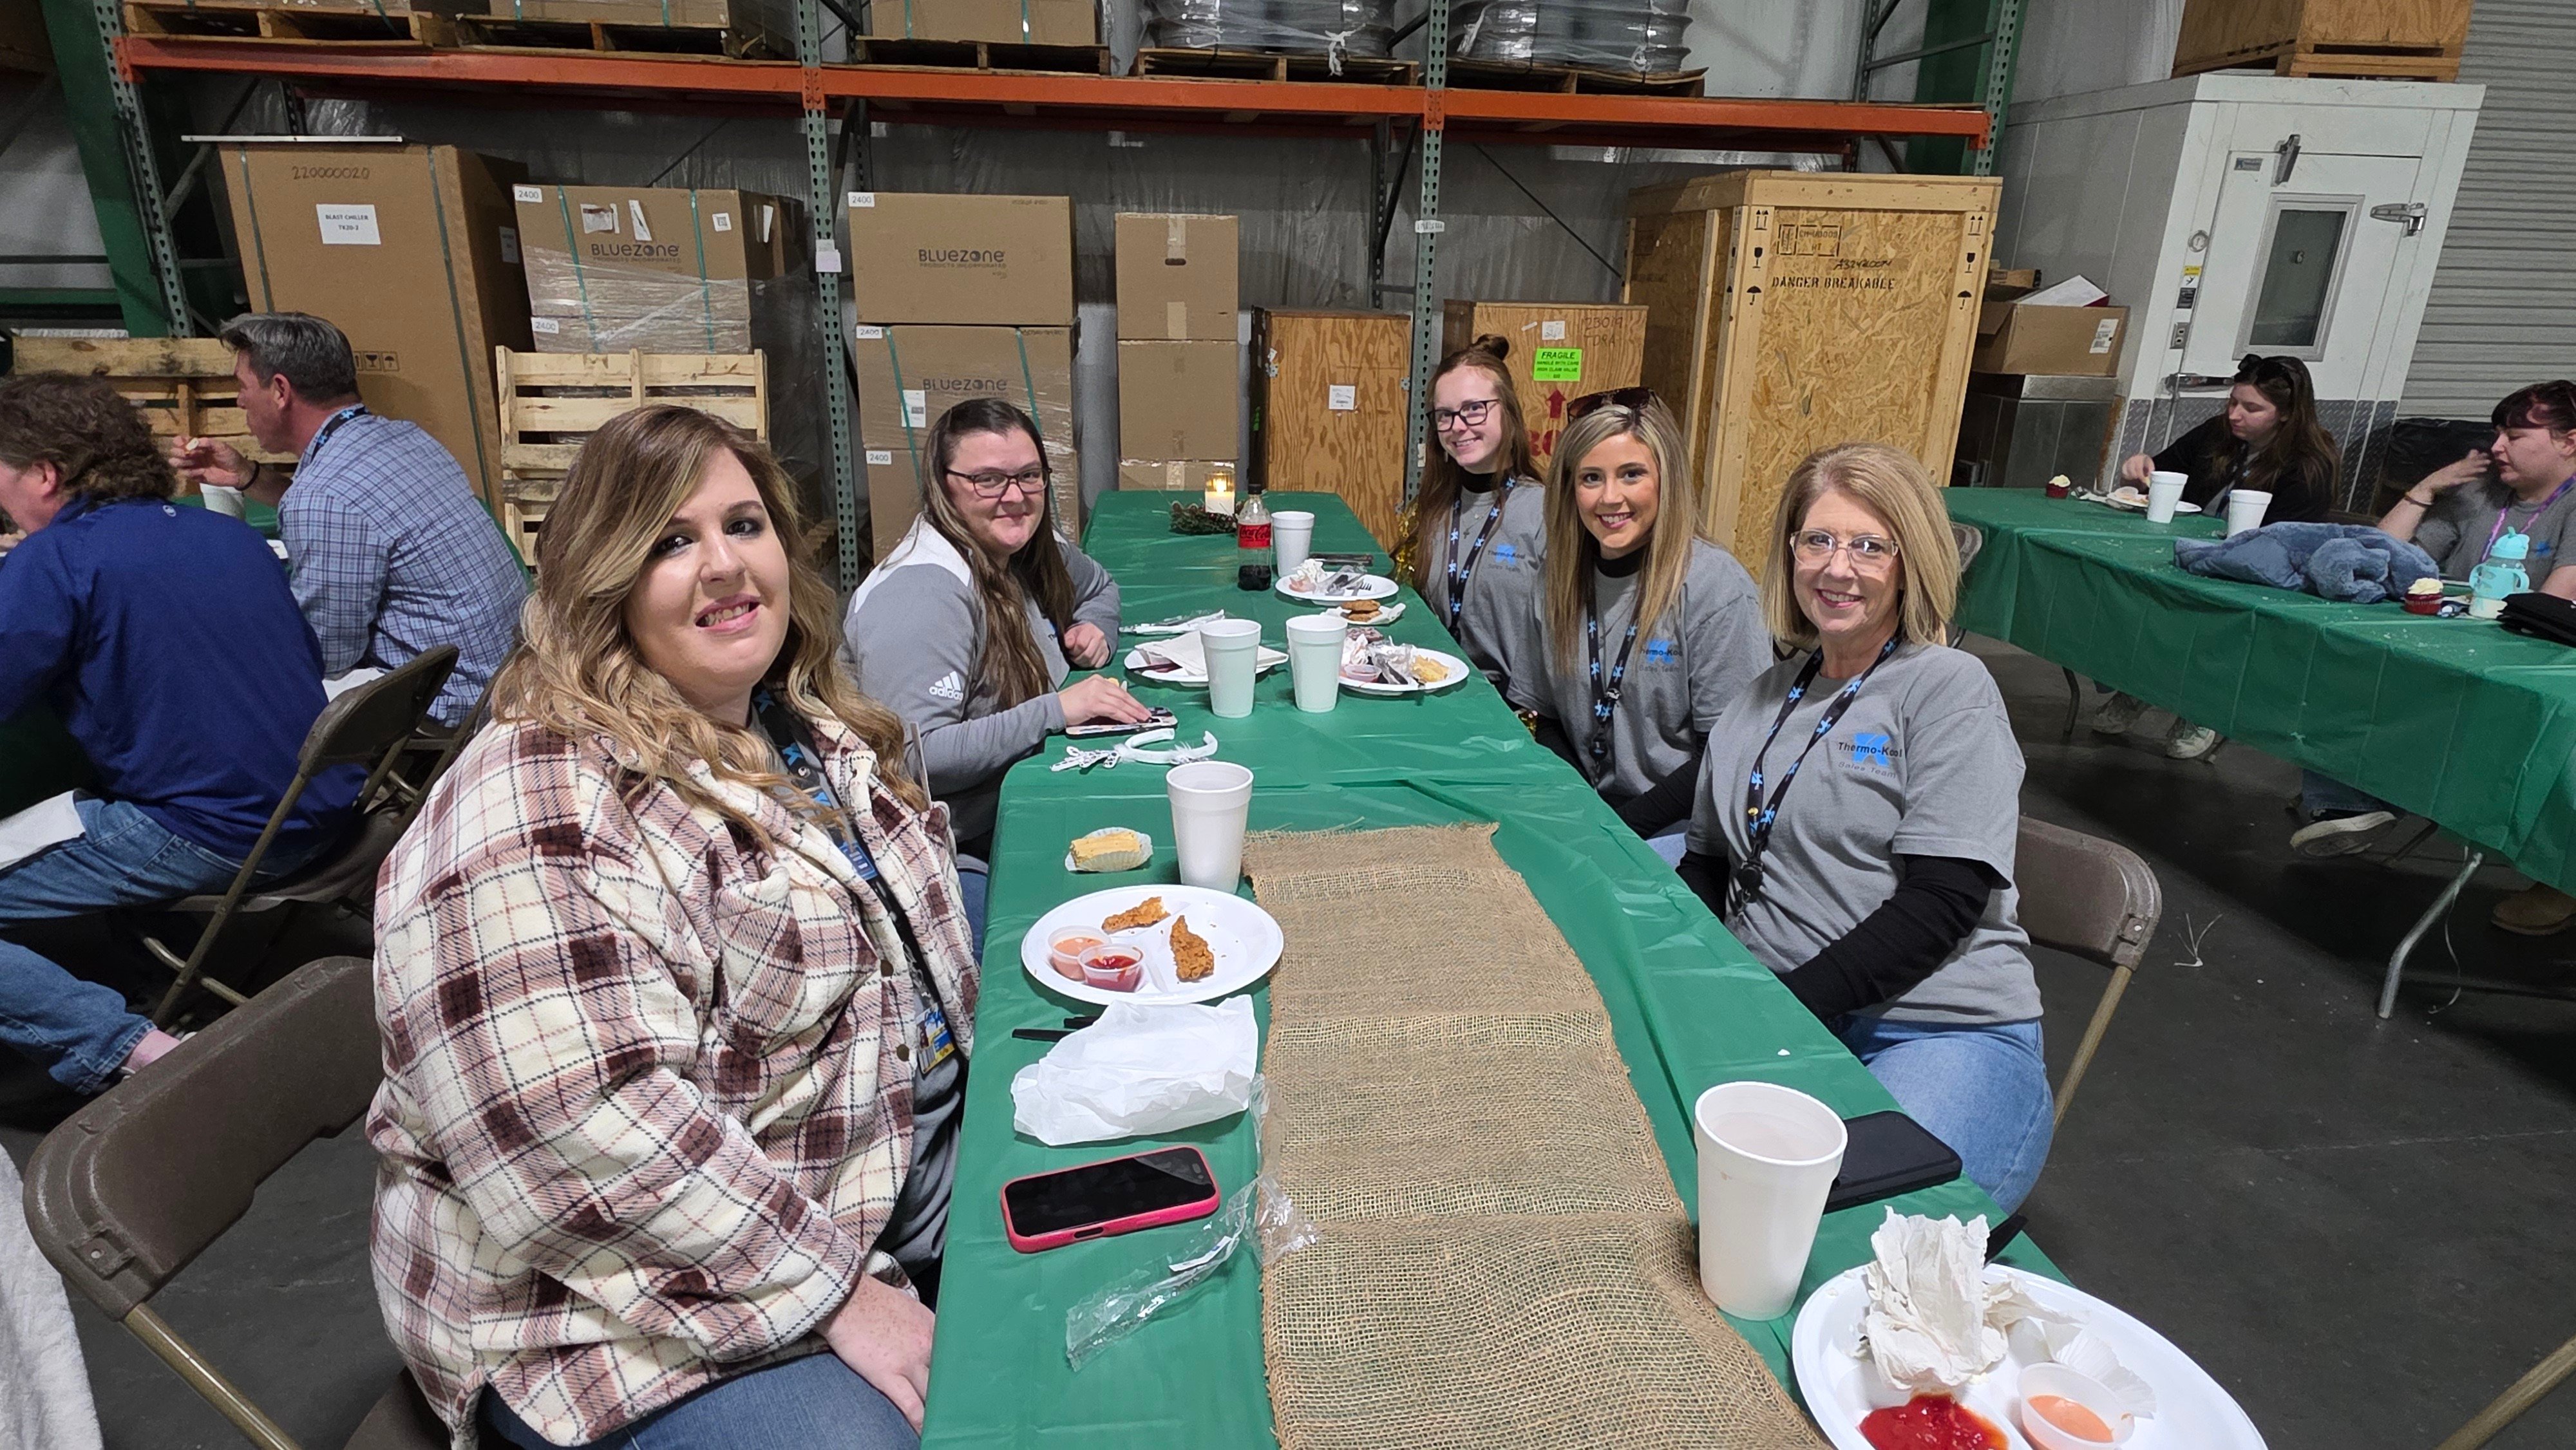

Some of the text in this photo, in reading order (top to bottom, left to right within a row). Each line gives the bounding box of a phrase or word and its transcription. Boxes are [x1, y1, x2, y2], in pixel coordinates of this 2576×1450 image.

[518, 190, 539, 199] 2400
[1772, 276, 1895, 289] DANGER BREAKABLE
[869, 453, 889, 462] 2400
[929, 686, 963, 701] adidas
[1838, 742, 1902, 758] Thermo-Kool
[1838, 761, 1896, 779] Sales Team
